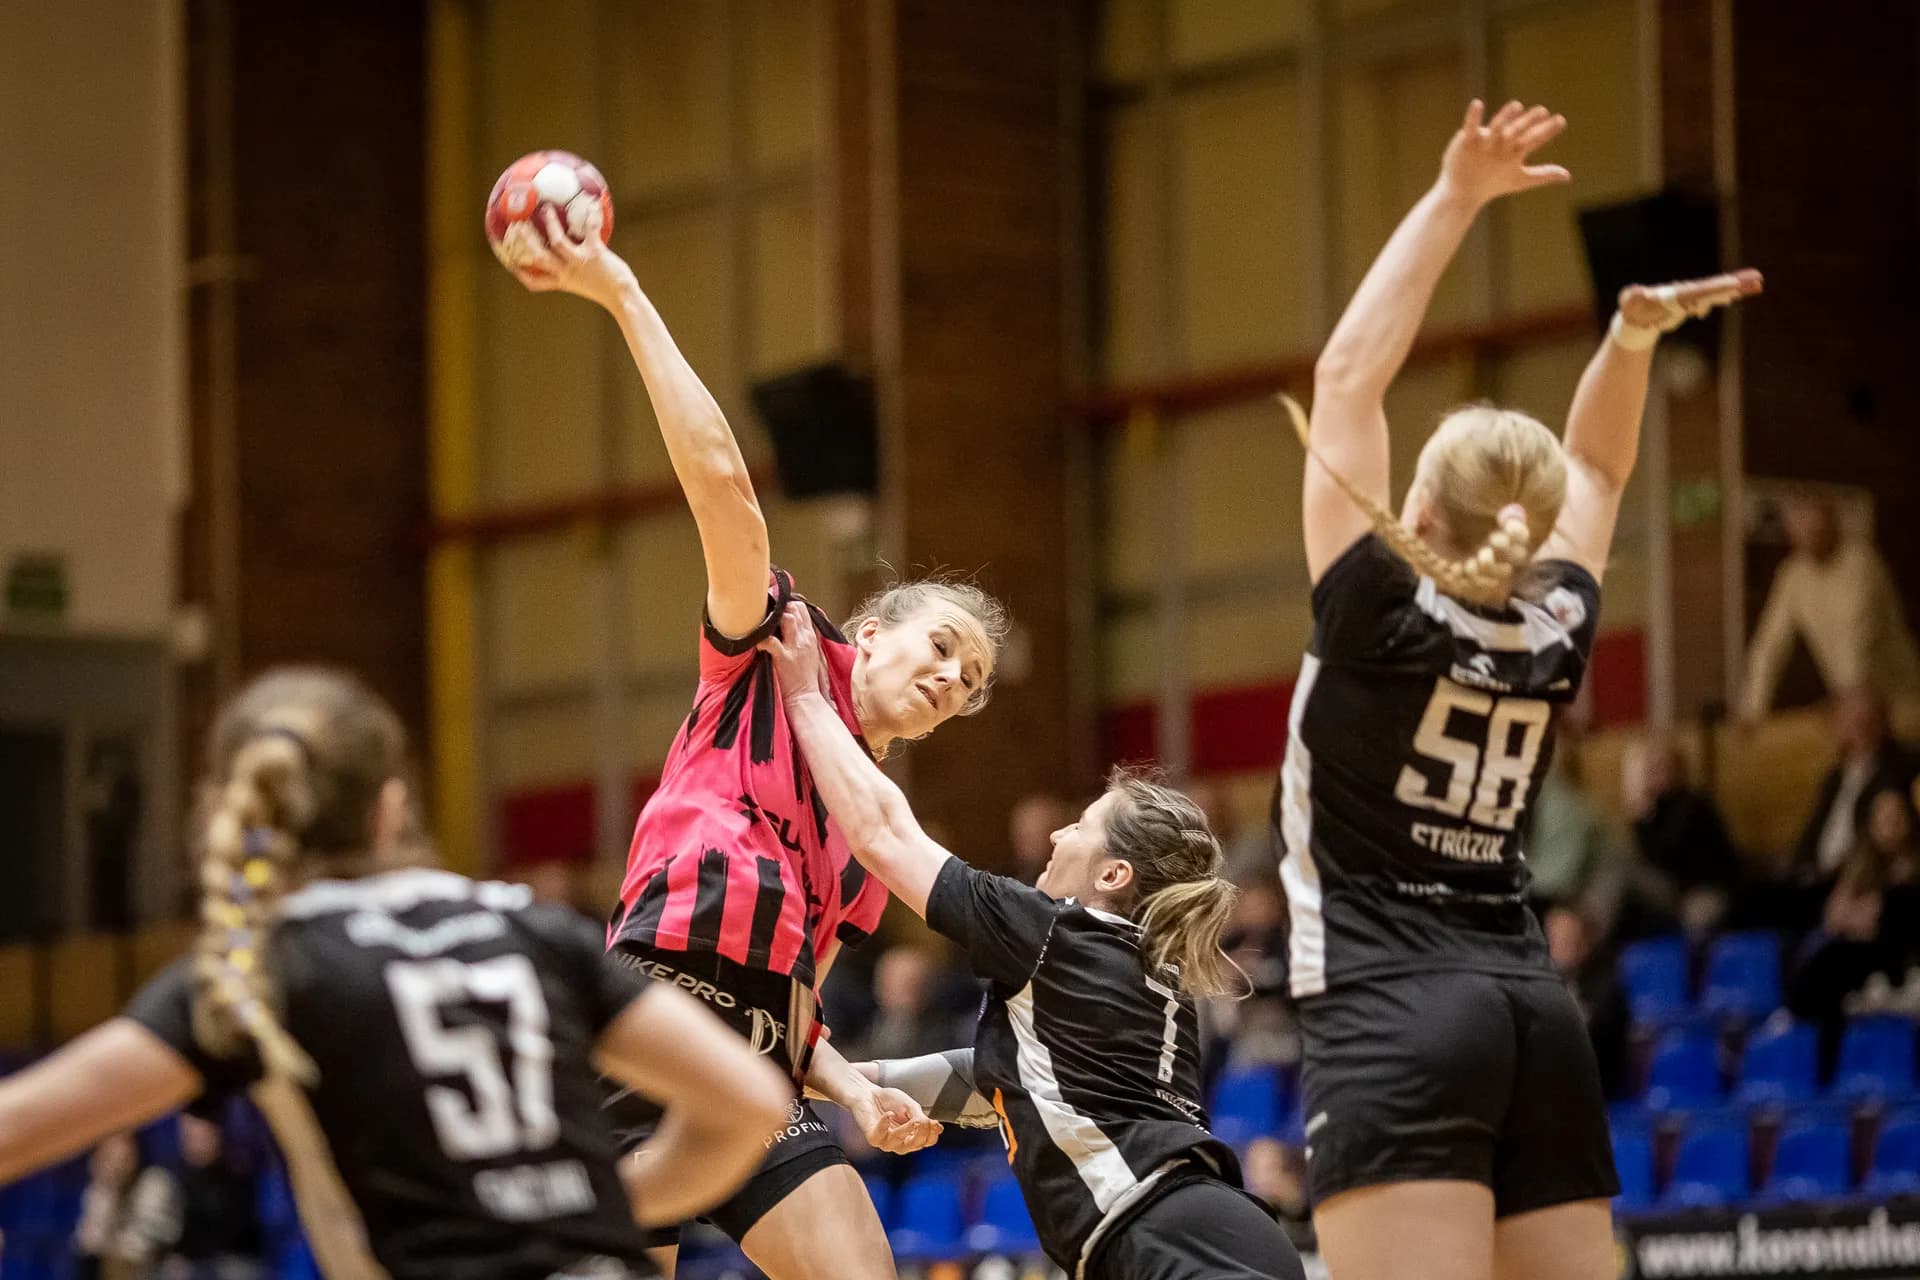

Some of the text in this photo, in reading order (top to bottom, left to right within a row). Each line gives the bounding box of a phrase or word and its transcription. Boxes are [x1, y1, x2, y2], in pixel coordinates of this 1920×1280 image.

[1394, 675, 1551, 831] 58
[384, 952, 560, 1161] 57
[671, 972, 736, 1008] PRO
